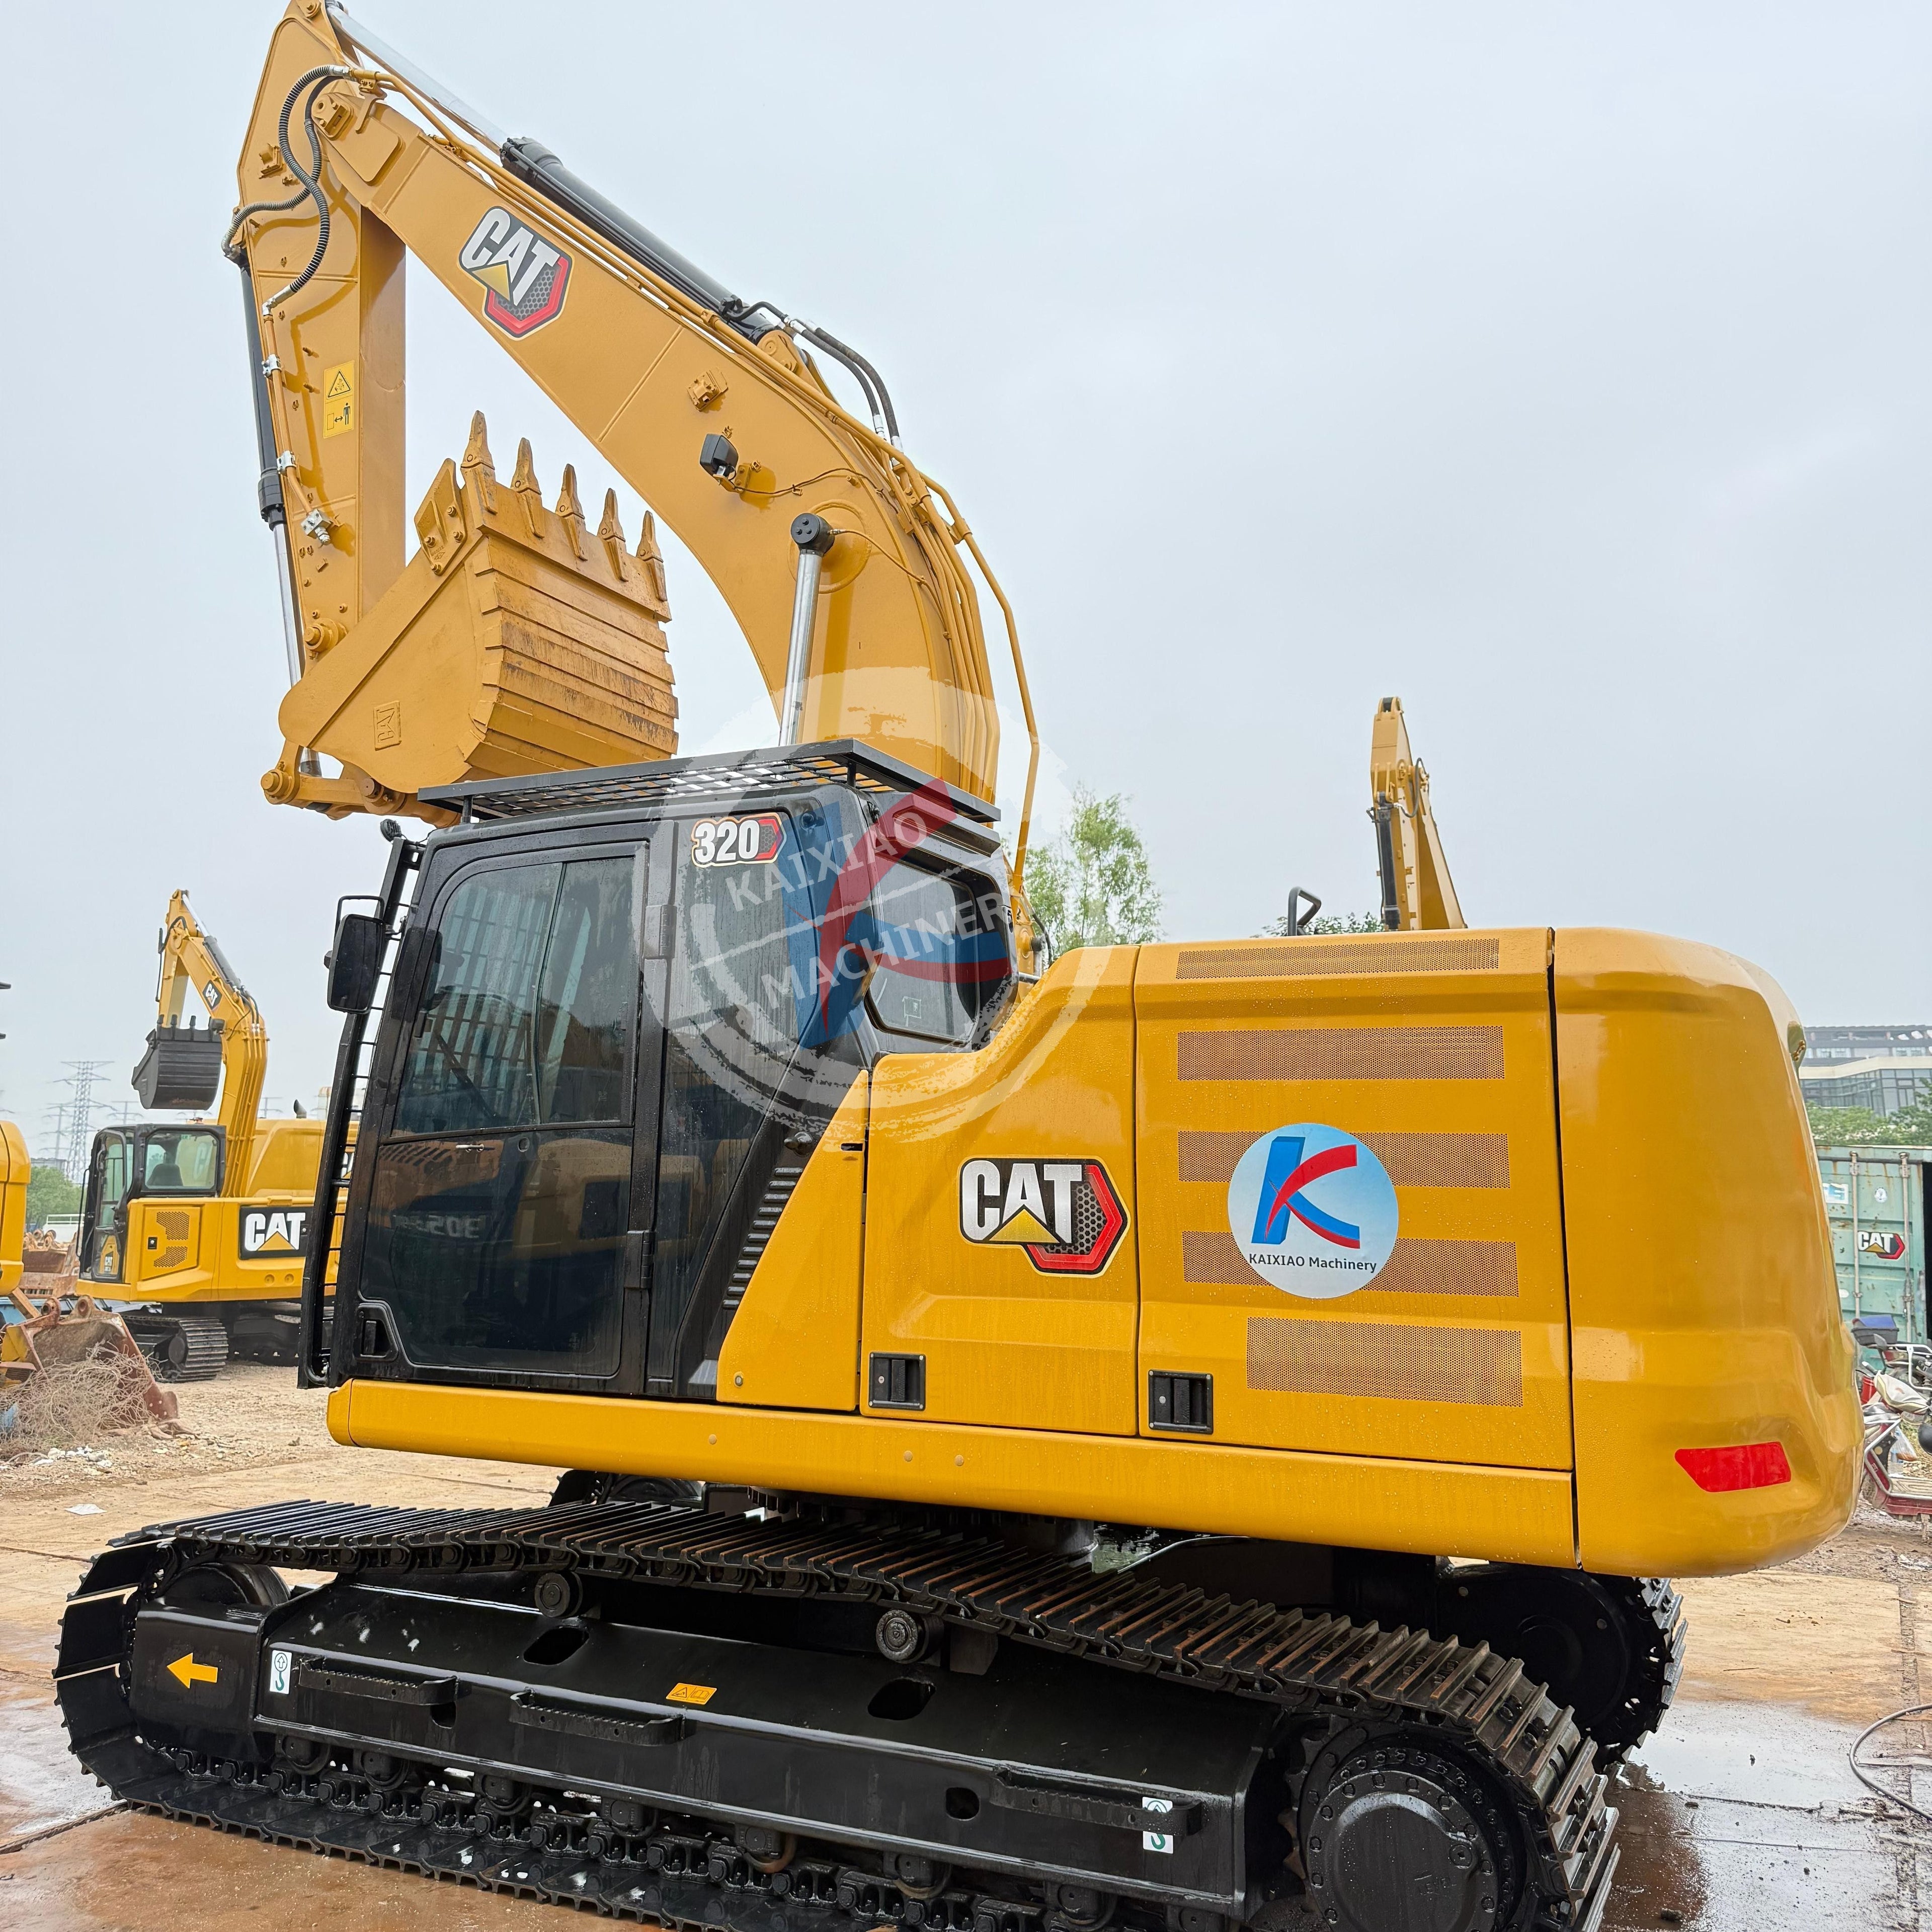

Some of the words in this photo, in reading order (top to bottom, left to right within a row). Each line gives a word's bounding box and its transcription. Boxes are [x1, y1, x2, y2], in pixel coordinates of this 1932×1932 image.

[461, 208, 560, 306] CAT
[375, 707, 395, 744] CAT
[695, 820, 760, 863] 320
[205, 983, 218, 1007] CAT
[962, 1160, 1082, 1244] CAT
[245, 1212, 306, 1251] CAT
[1858, 1231, 1894, 1253] CAT
[1249, 1253, 1305, 1266] KAIXIAO
[1309, 1257, 1377, 1273] Machinery
